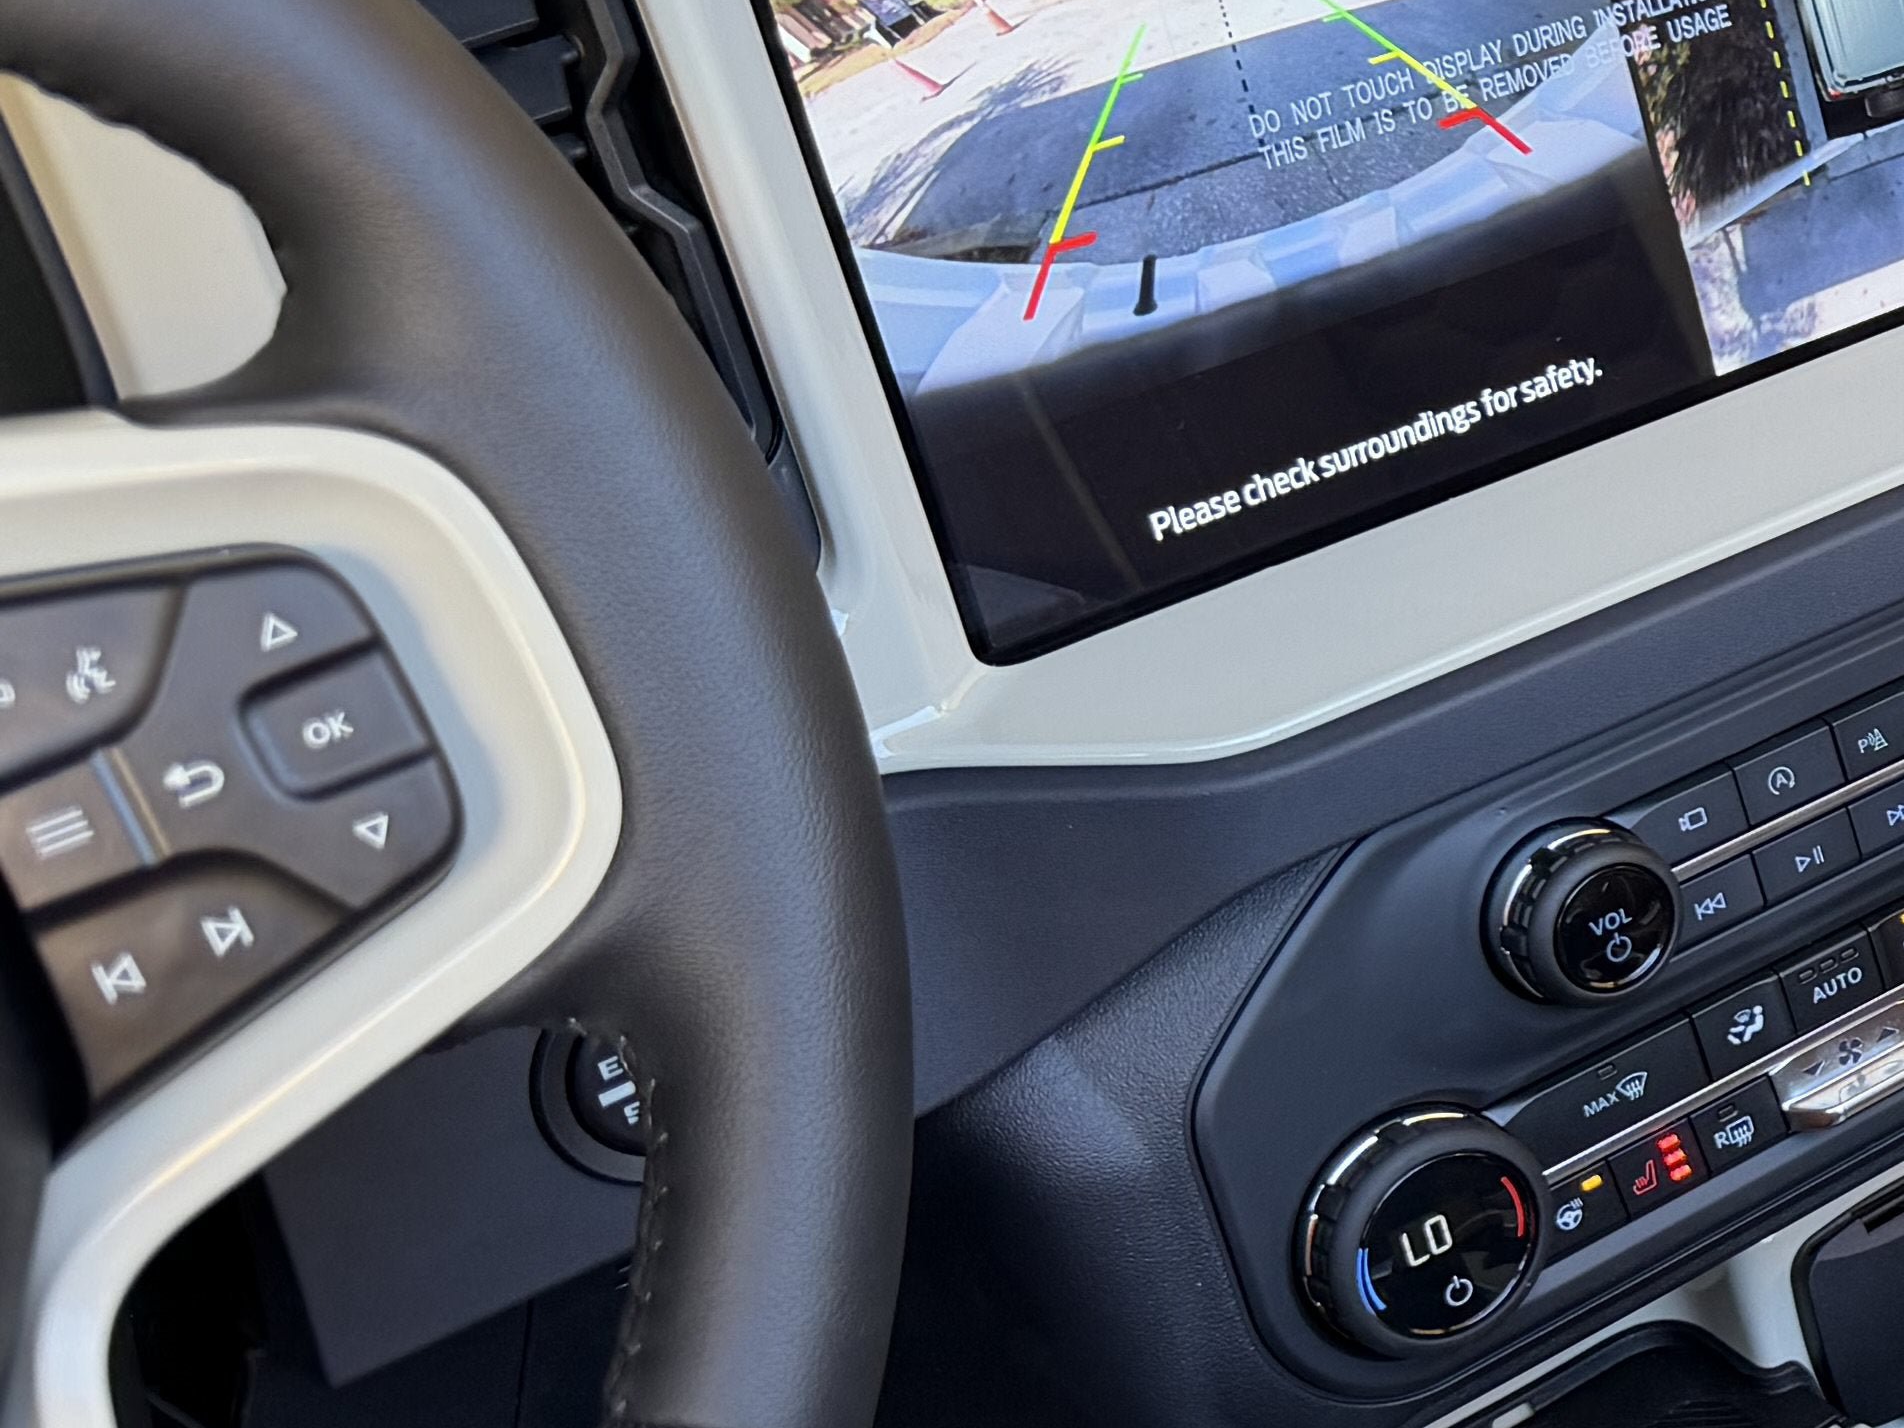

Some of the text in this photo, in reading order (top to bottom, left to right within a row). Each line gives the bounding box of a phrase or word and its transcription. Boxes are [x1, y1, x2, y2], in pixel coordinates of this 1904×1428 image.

[1248, 111, 1283, 139] DO
[1291, 92, 1332, 128] NOT
[1341, 68, 1415, 109] TOUCH
[1423, 40, 1502, 79] DISPLAY
[1512, 16, 1587, 57] DURING
[1258, 3, 1732, 170] THIS FILM IS TO BE REMOVED BEFORE USAGE
[1149, 356, 1603, 541] Please check surroundings for safety.
[302, 710, 354, 748] OK
[1588, 908, 1633, 936] VOL
[1813, 967, 1862, 1004] AUTO
[1583, 1090, 1620, 1118] MAX
[1402, 1214, 1453, 1266] LO
